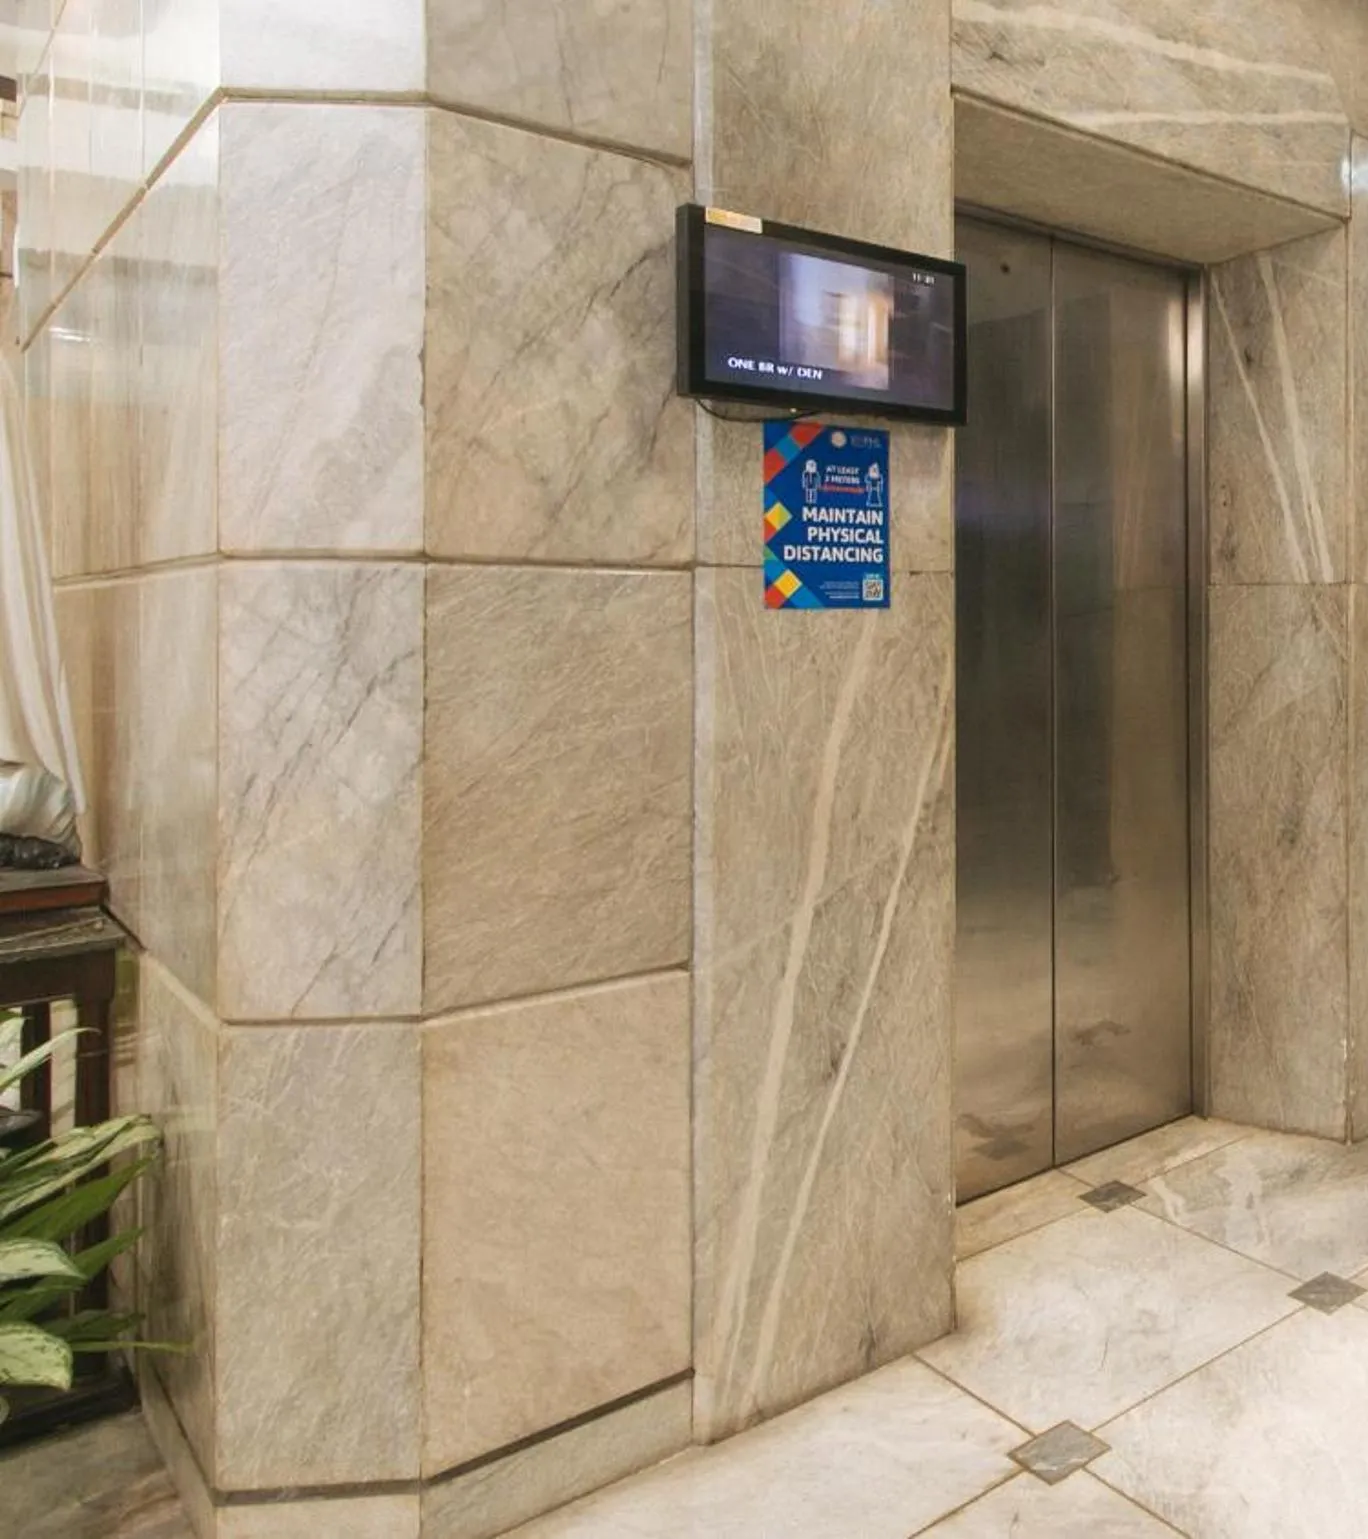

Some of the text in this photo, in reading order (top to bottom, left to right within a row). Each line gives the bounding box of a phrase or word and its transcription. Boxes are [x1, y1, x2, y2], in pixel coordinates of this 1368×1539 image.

[727, 357, 756, 371] ONE
[802, 506, 883, 525] MAINTAIN
[808, 526, 884, 544] PHYSICAL
[784, 545, 883, 564] DISTANCING
